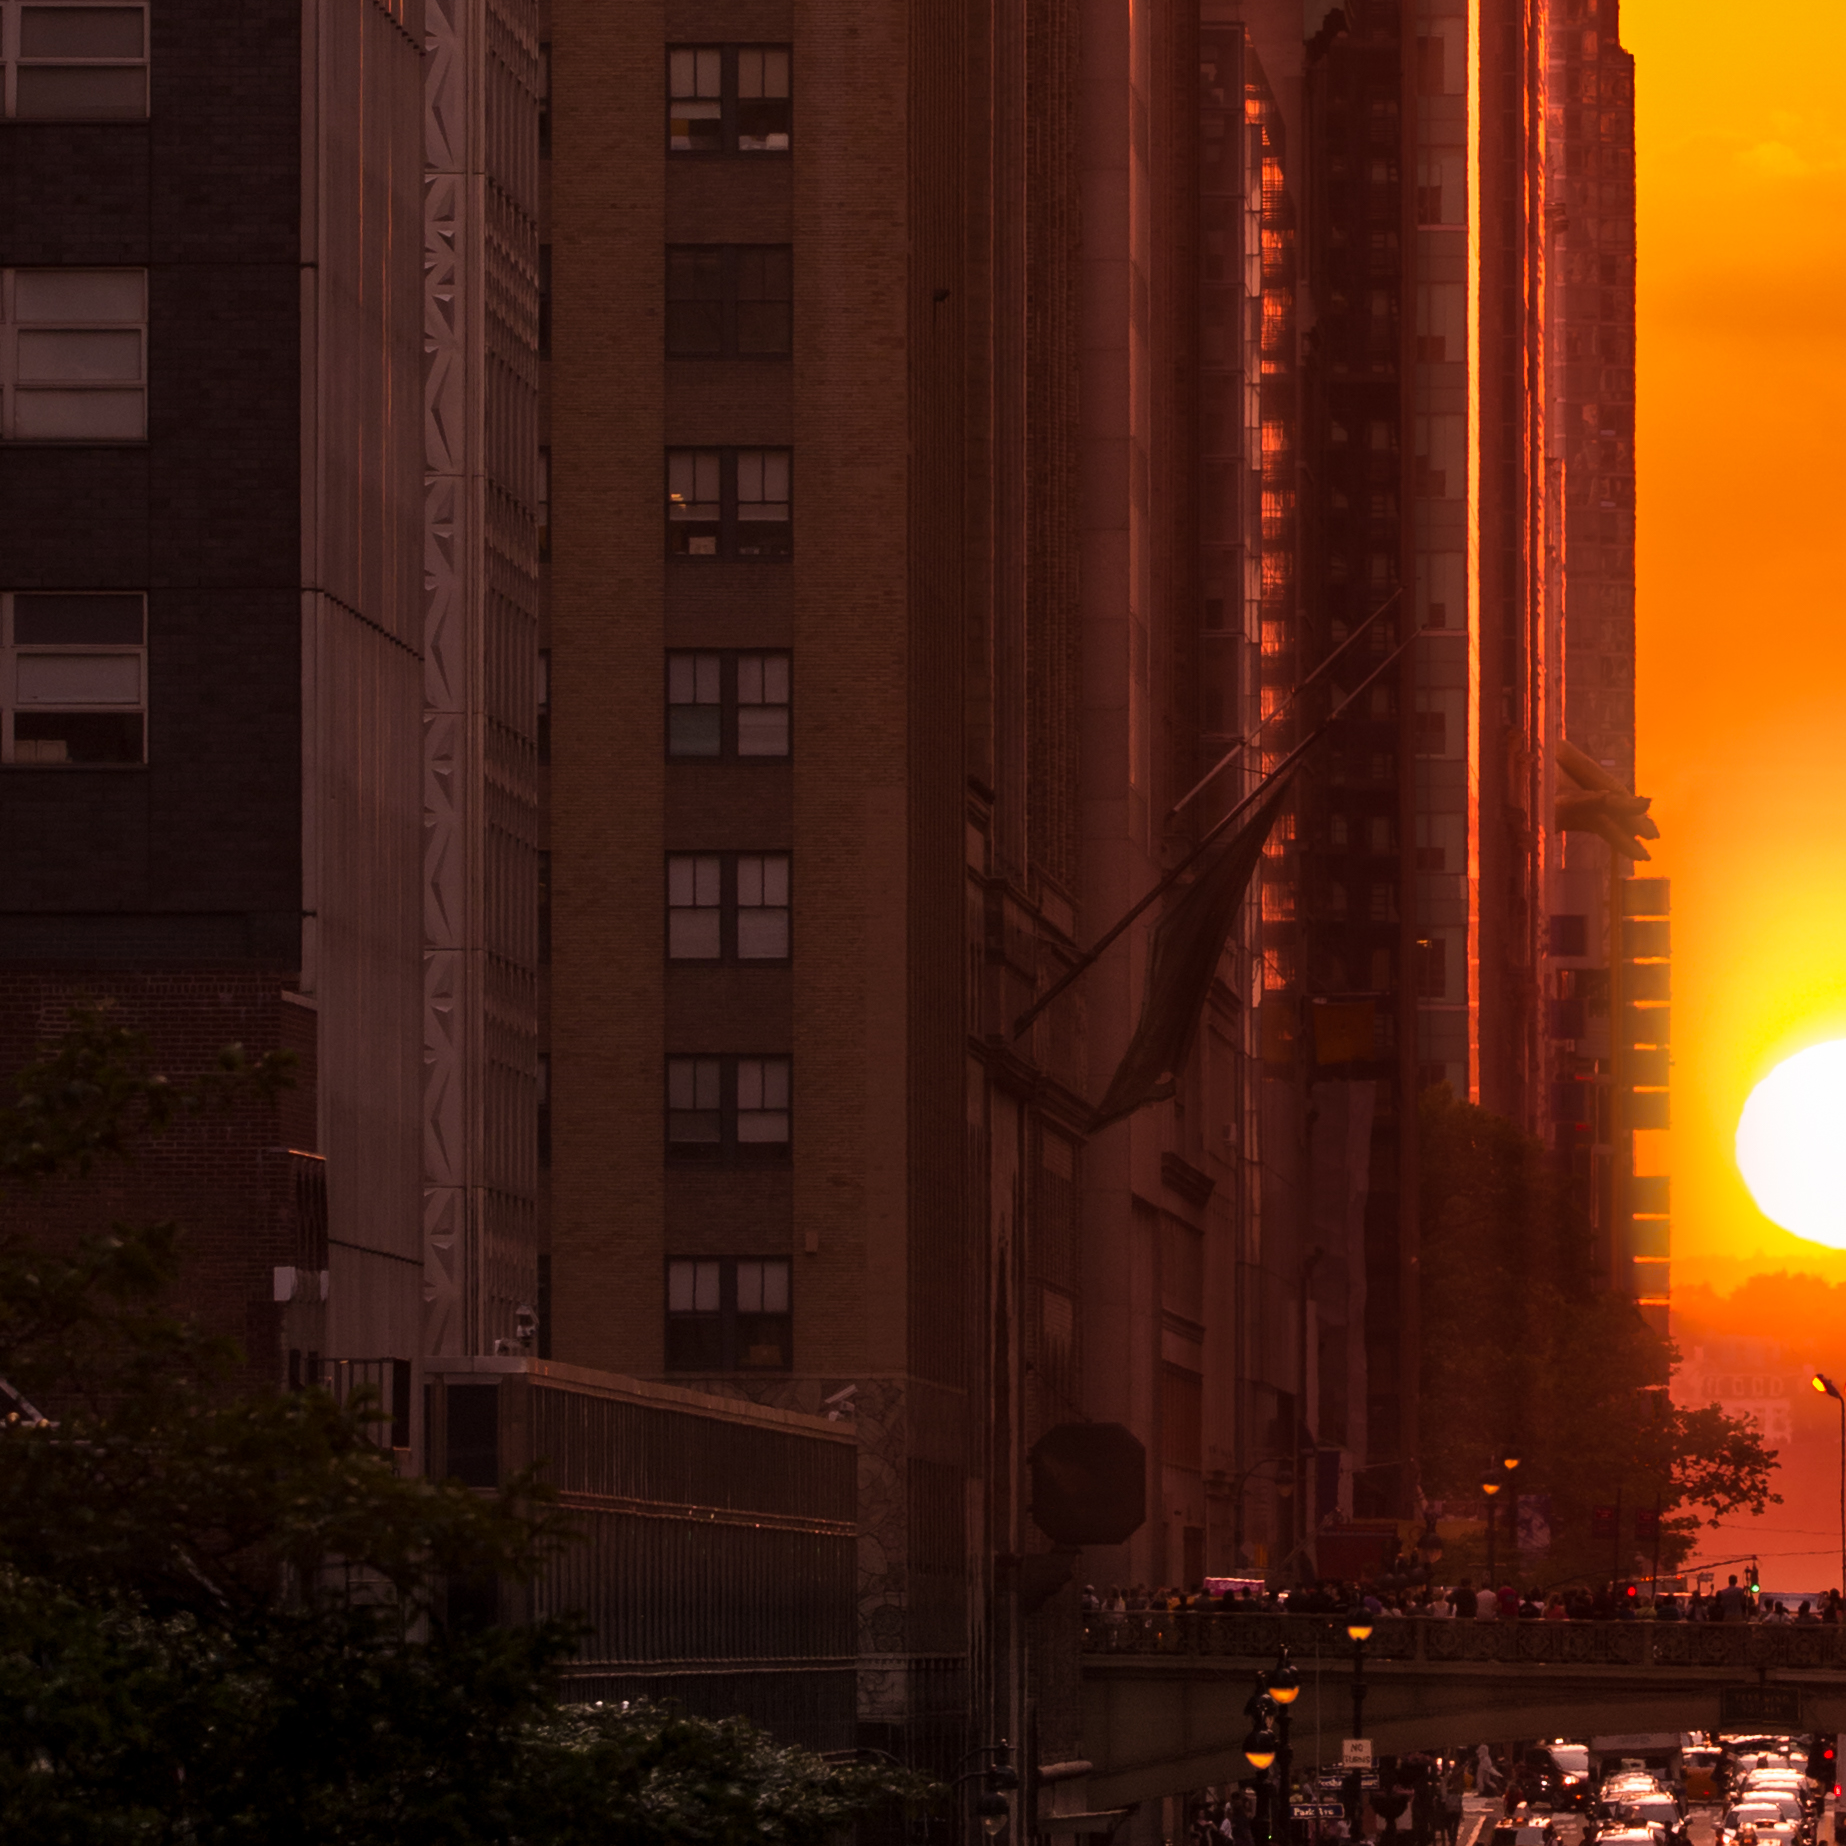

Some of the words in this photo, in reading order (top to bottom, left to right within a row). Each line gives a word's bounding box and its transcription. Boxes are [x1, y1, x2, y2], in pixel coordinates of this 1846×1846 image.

[1350, 1744, 1363, 1752] NO
[1345, 1756, 1370, 1764] TURNS
[1293, 1808, 1315, 1816] Park
